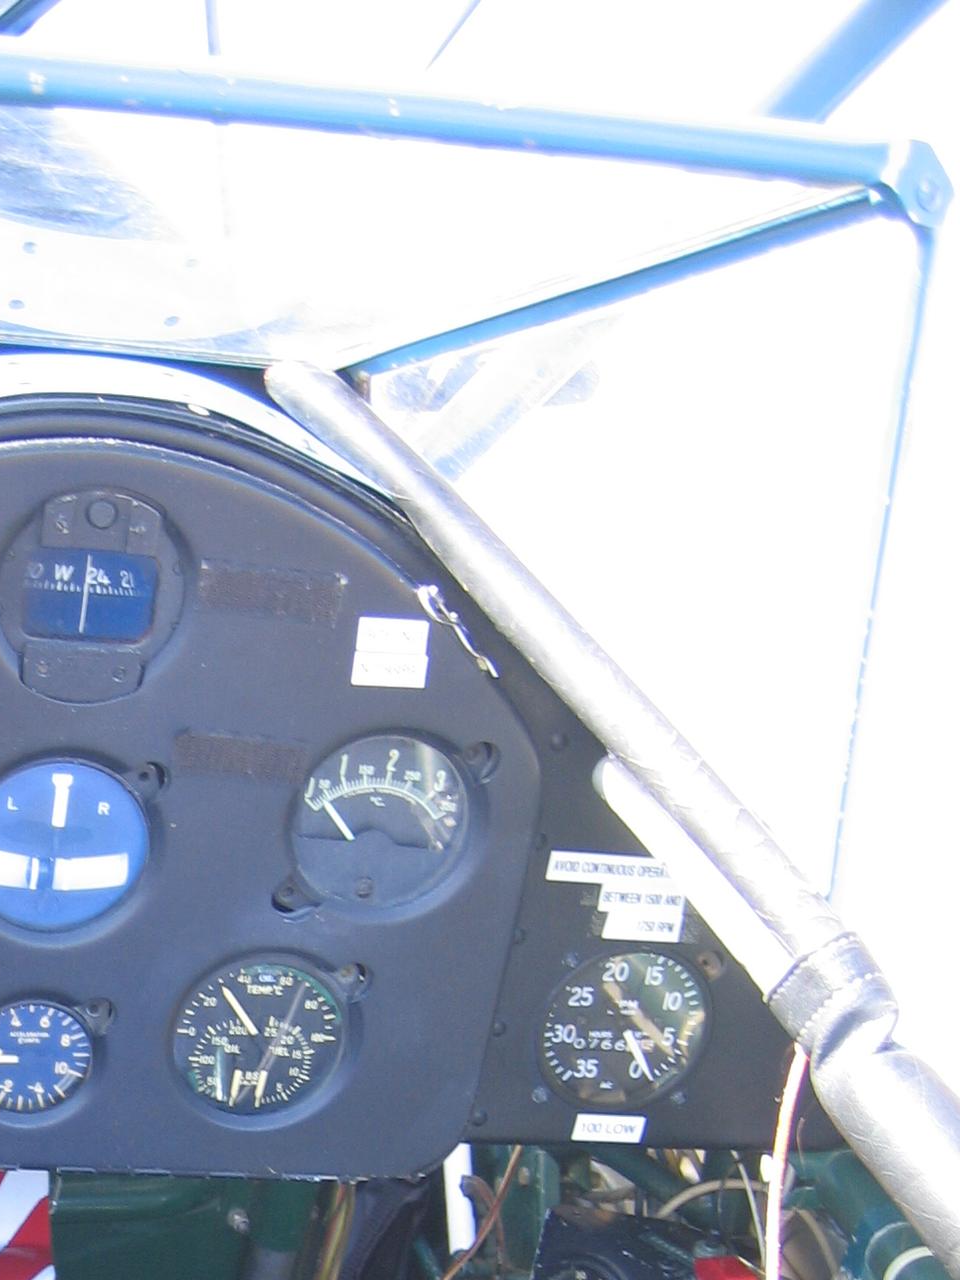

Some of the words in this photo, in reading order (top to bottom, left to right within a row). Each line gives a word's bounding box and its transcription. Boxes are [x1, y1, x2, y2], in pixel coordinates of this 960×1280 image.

[54, 563, 74, 581] W
[87, 567, 111, 585] 24
[120, 570, 134, 588] 21
[386, 749, 400, 772] 2
[433, 770, 446, 792] 3
[6, 796, 19, 811] L
[97, 801, 111, 816] R
[552, 859, 581, 874] AVOID
[581, 861, 635, 877] CONTINUOUS
[602, 891, 641, 905] BETWEEN
[602, 962, 629, 982] 20
[644, 966, 665, 985] 15
[203, 997, 217, 1008] 20
[567, 987, 594, 1006] 25
[662, 991, 682, 1011] 10
[10, 1014, 23, 1028] 4
[40, 1016, 51, 1029] 6
[60, 1034, 72, 1047] 8
[551, 1024, 576, 1043] 30
[661, 1027, 675, 1046] 5
[54, 1061, 69, 1074] 10
[573, 1058, 599, 1078] 35
[628, 1060, 643, 1079] 0
[604, 1123, 637, 1134] LOW
